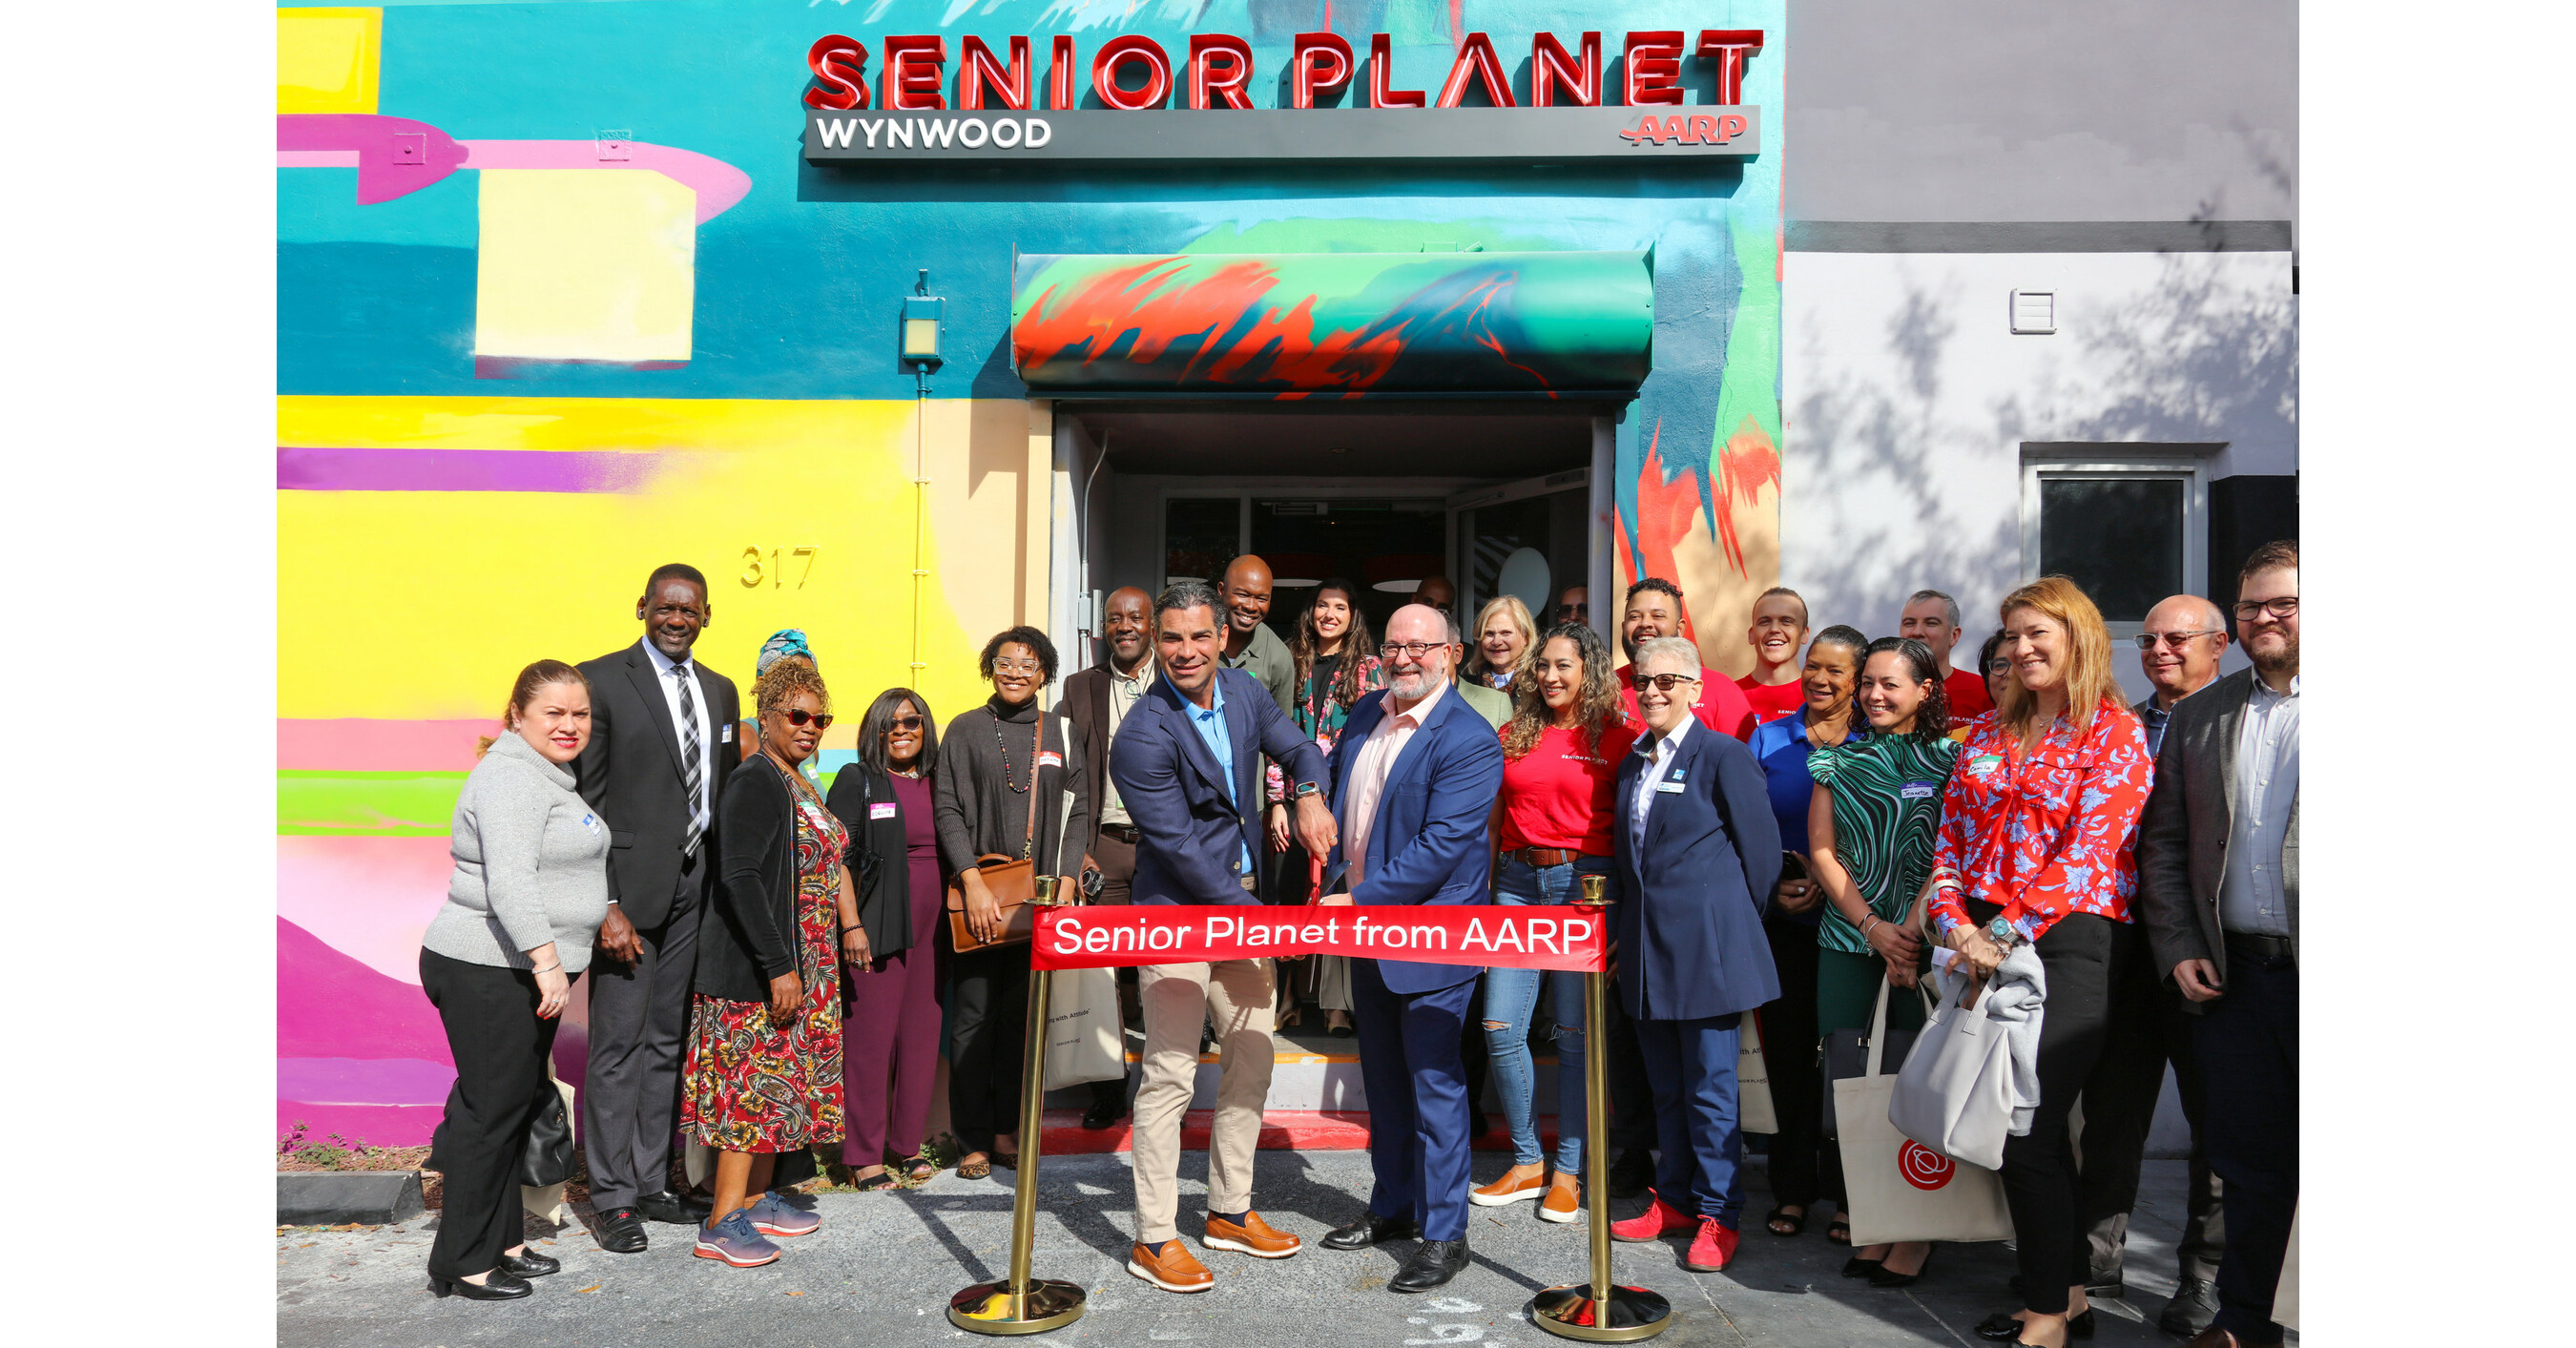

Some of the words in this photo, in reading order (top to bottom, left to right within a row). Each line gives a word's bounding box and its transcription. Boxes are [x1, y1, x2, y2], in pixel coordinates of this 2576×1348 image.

[803, 34, 1255, 111] SENIOR
[1293, 31, 1765, 109] PLANET
[816, 117, 1052, 151] WYNWOOD
[1619, 114, 1748, 147] AARP
[739, 544, 821, 590] 317
[1053, 918, 1191, 955] Senior
[1205, 916, 1339, 949] Planet
[1352, 916, 1447, 949] from
[1460, 918, 1591, 954] AARP
